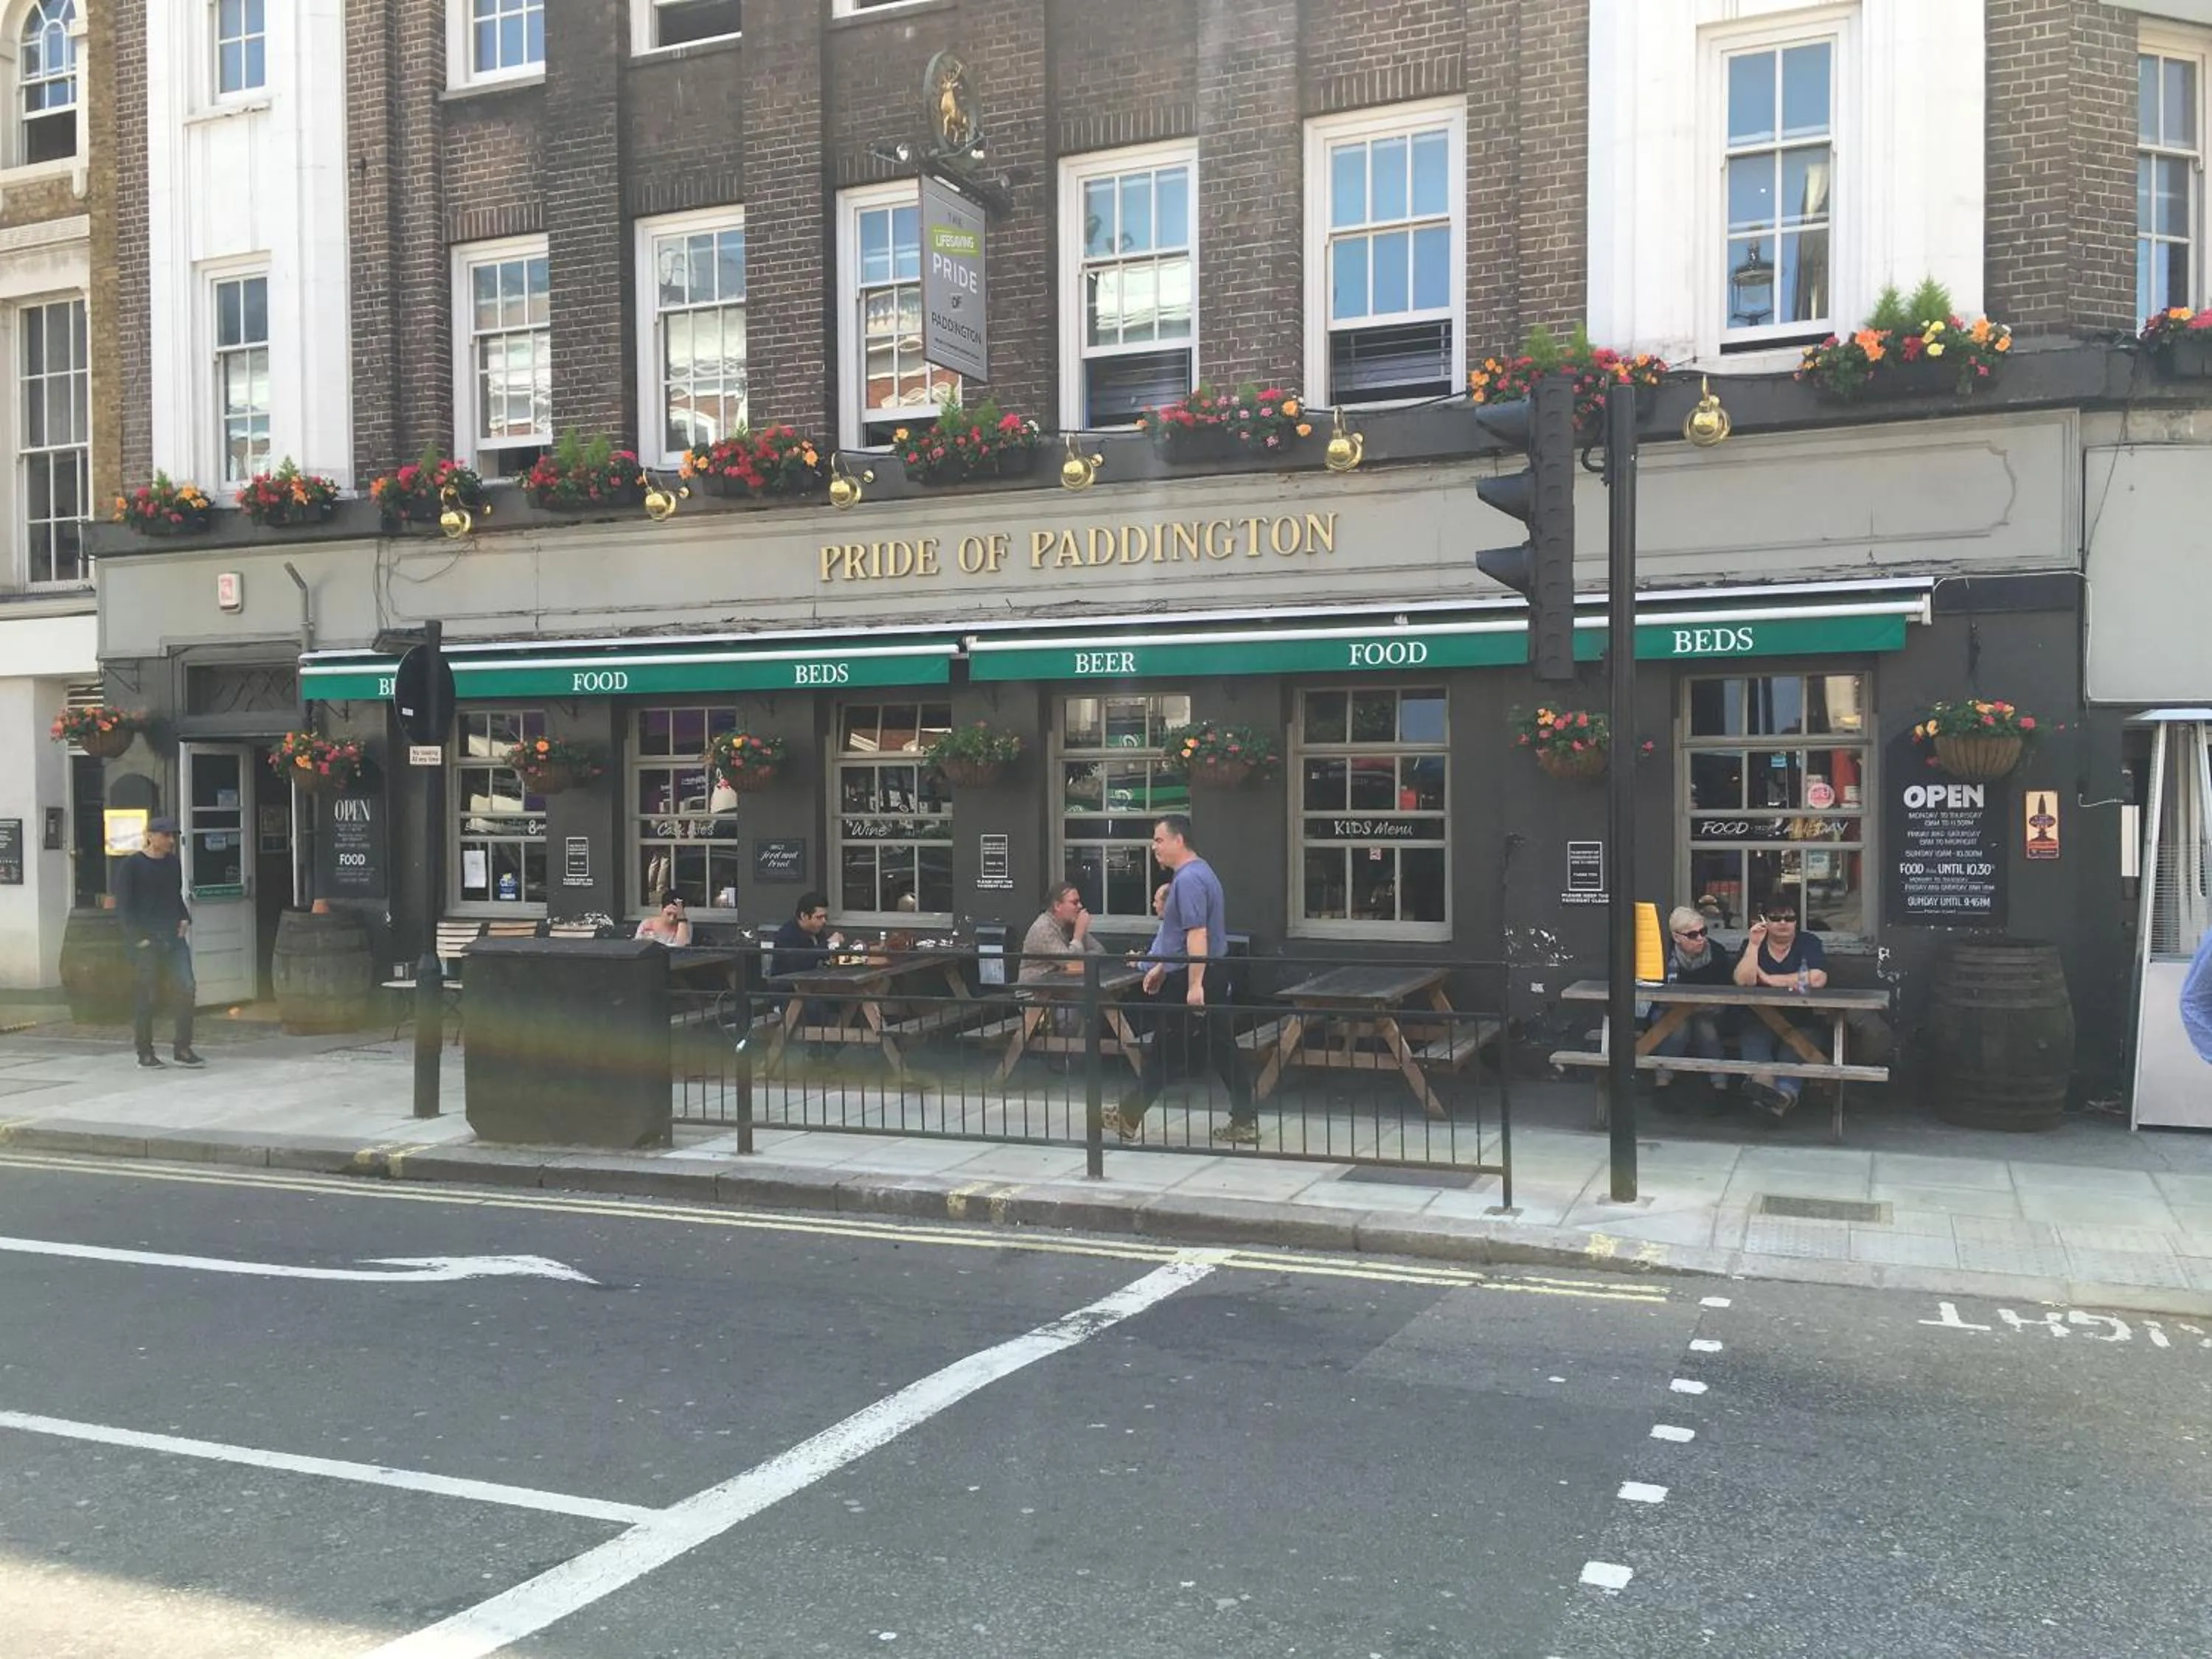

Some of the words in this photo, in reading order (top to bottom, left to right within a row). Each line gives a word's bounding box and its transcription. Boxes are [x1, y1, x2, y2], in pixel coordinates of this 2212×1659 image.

[933, 251, 978, 294] PRIDE
[952, 295, 962, 308] OF
[931, 311, 983, 346] PADDINGTON
[820, 538, 940, 582] PRIDE
[958, 532, 1011, 574] OF
[1029, 511, 1339, 570] PADDINGTON
[1673, 627, 1754, 653] BEDS
[1074, 652, 1136, 673] BEER
[1349, 641, 1427, 666] FOOD
[572, 672, 628, 692] FOOD
[794, 663, 849, 685] BEDS
[1903, 785, 1984, 809] OPEN
[335, 799, 370, 821] OPEN
[1334, 821, 1371, 835] KIDS
[1374, 821, 1413, 835] Menu
[1700, 820, 1749, 835] FOOD
[339, 853, 366, 866] FOOD
[1899, 863, 1924, 875] FOOD
[1937, 863, 1964, 875] UNTIL
[1907, 896, 1938, 906] SUNDAY
[1940, 897, 1962, 906] UNTIL
